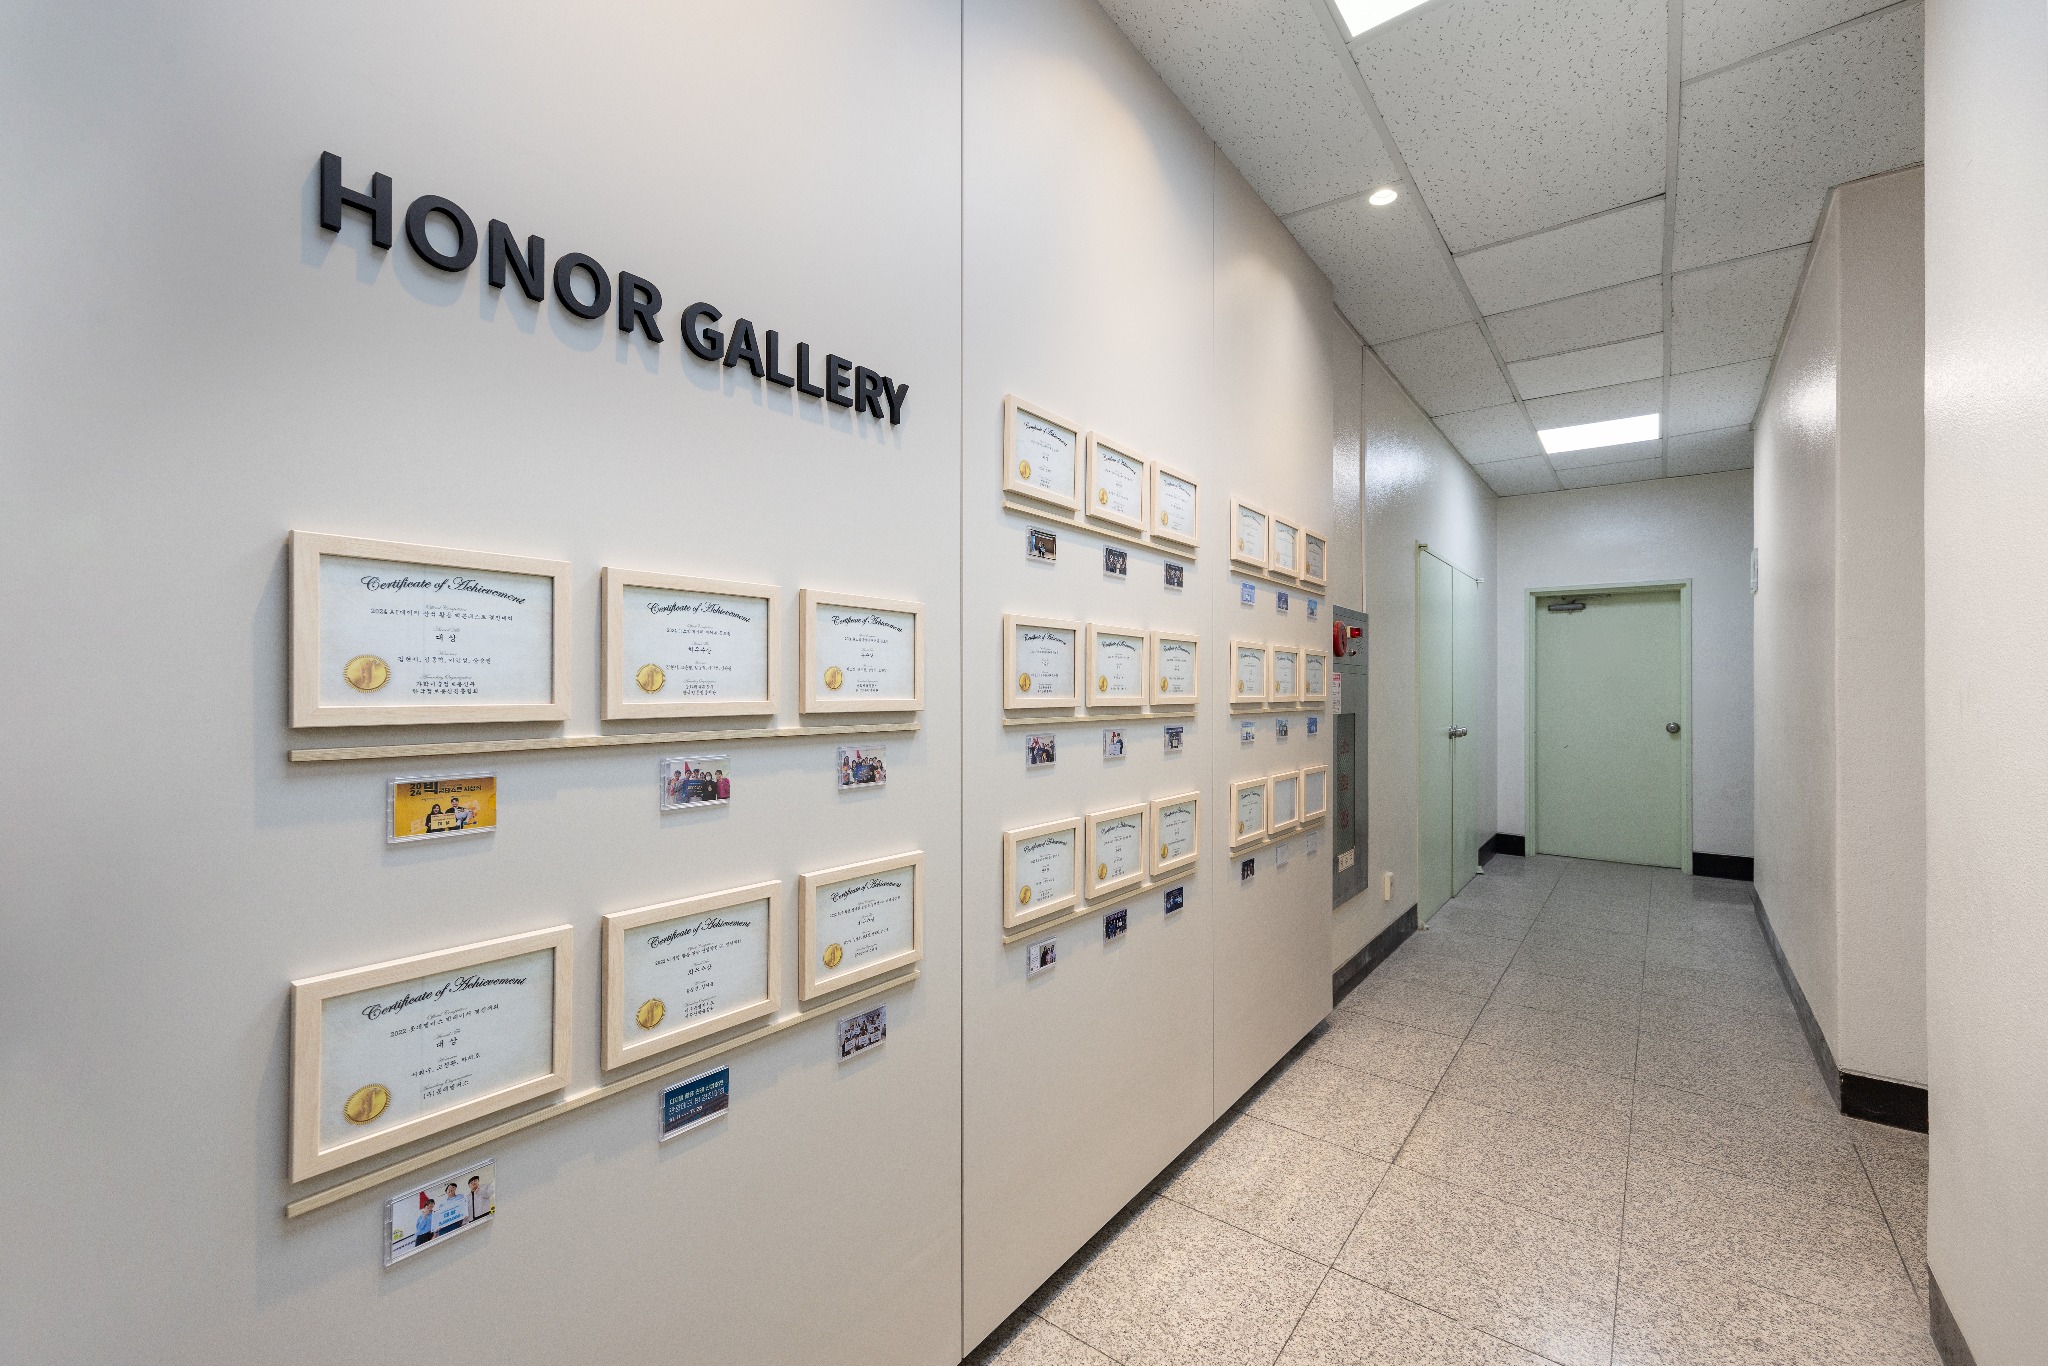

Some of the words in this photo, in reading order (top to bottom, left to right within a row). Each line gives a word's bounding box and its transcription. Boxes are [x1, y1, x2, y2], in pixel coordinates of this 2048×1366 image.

[320, 150, 664, 344] HONOR
[680, 301, 909, 425] GALLERY
[361, 576, 431, 592] Certificate
[433, 578, 449, 593] of
[448, 576, 526, 605] Achievement
[647, 601, 692, 616] Certificate
[692, 603, 703, 614] of
[700, 601, 751, 623] Achievement
[410, 782, 422, 790] 20
[410, 789, 422, 797] 24
[647, 927, 692, 949] Certificate
[692, 921, 703, 937] of
[701, 917, 751, 931] Achievement
[361, 991, 433, 1021] Certificate
[434, 982, 451, 1002] of
[449, 974, 527, 993] Achievement
[390, 1028, 407, 1038] 2022
